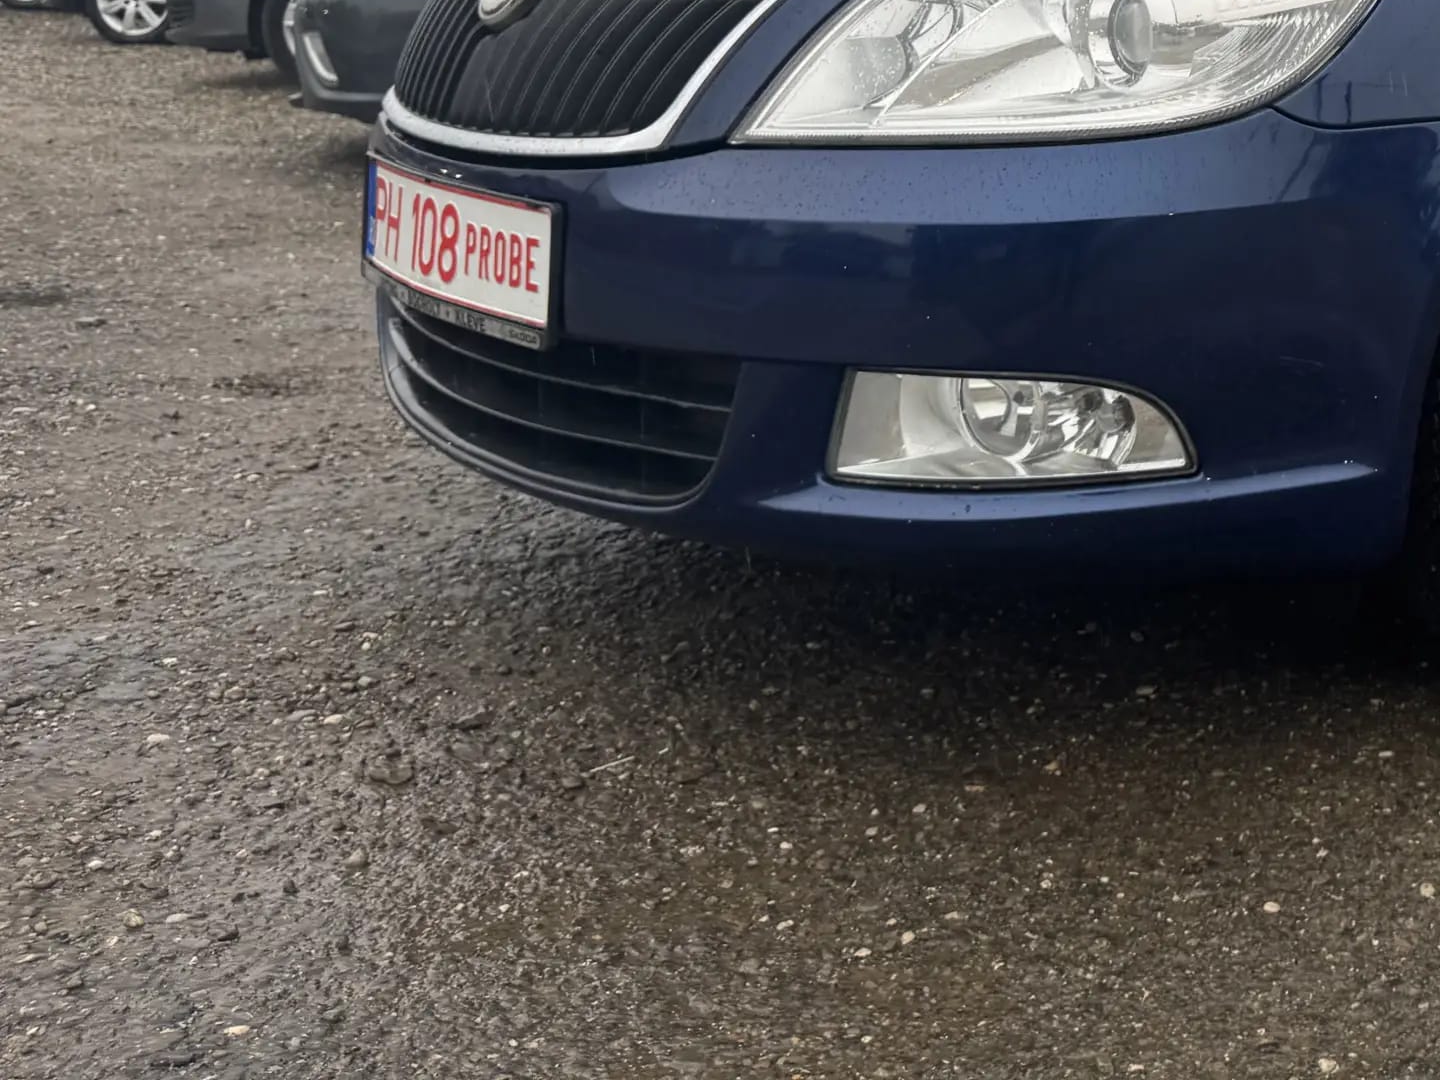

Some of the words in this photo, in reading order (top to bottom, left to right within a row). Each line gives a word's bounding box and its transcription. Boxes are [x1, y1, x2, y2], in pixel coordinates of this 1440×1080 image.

[375, 174, 403, 263] PH
[411, 192, 461, 283] 108
[464, 222, 541, 294] PROBE
